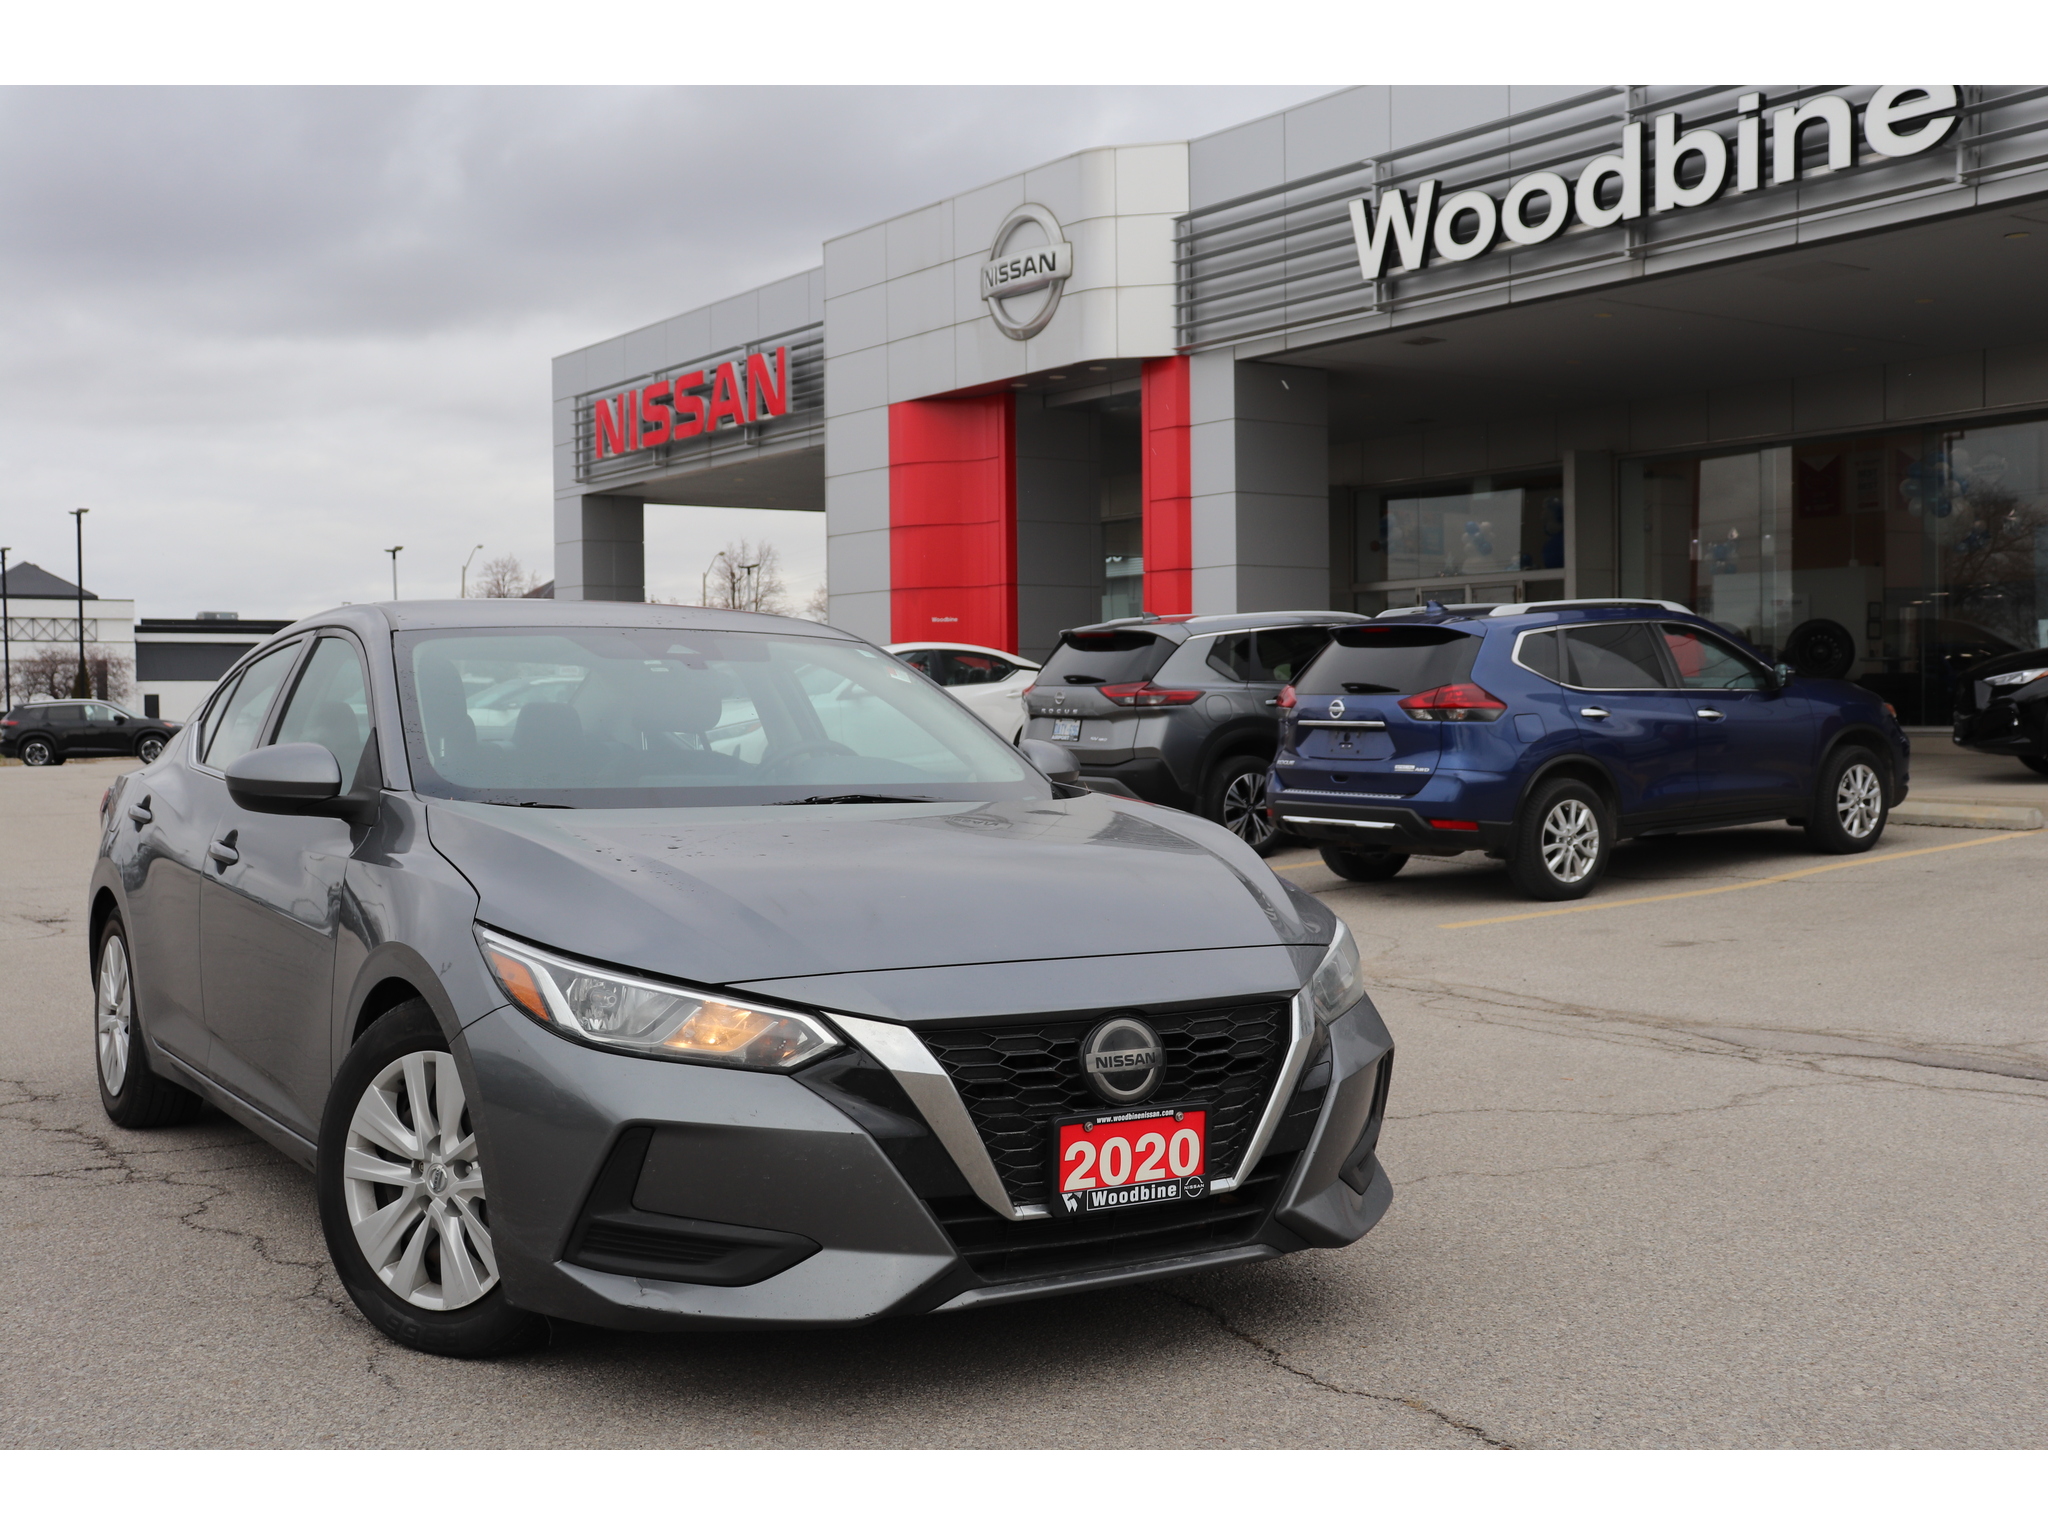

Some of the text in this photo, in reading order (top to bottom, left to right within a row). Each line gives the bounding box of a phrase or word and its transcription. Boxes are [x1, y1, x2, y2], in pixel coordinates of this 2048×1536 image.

[1348, 85, 1962, 281] Woodbine
[983, 251, 1057, 291] NISSAN
[594, 346, 792, 460] NISSAN
[1095, 1051, 1156, 1069] NISSAN
[1096, 1109, 1175, 1124] www.woodbinenissan.com
[1063, 1128, 1201, 1192] 2020
[1091, 1183, 1178, 1208] Woodbine
